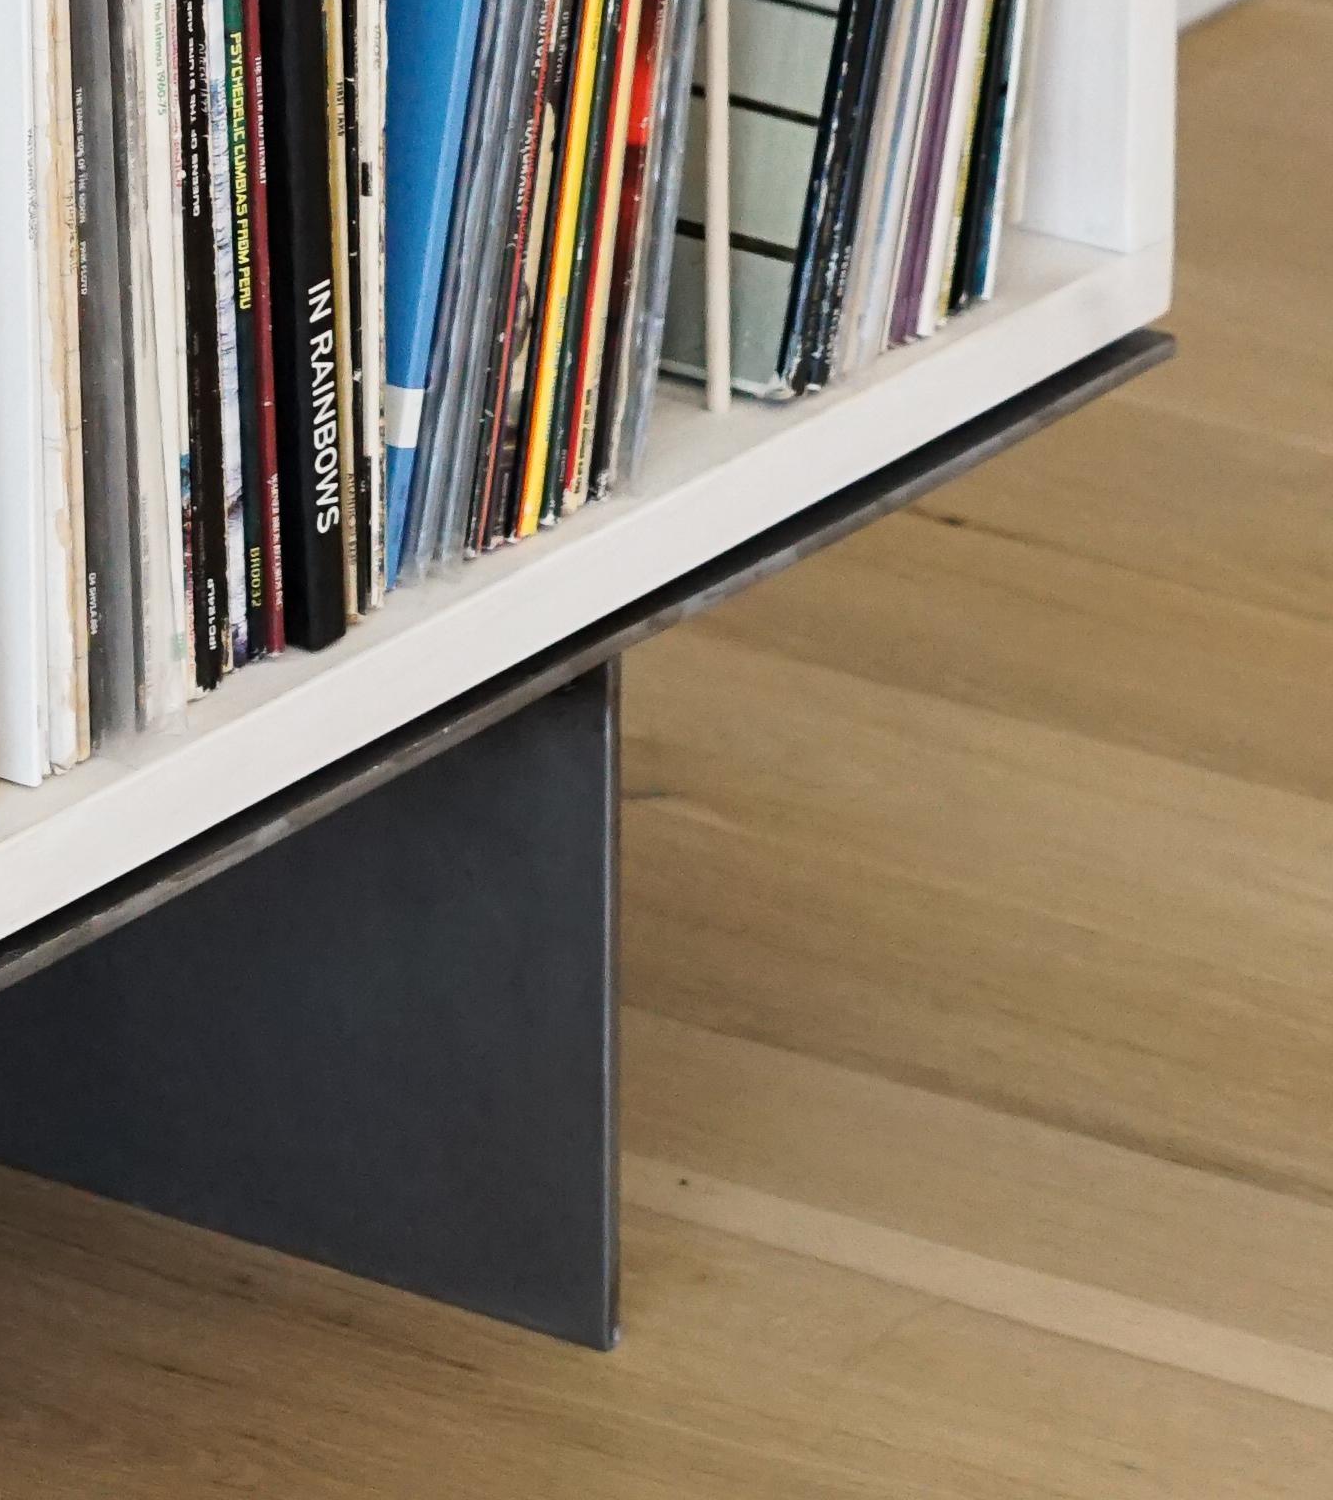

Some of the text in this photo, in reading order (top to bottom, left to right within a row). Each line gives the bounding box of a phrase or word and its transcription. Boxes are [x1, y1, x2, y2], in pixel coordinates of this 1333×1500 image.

[152, 2, 164, 21] the
[152, 22, 166, 68] Isthmus
[74, 87, 85, 107] THE
[155, 69, 168, 117] 1960-75
[185, 0, 201, 218] QUEENS OF THE STONE AGE
[229, 31, 246, 143] PSYCHEDELIC
[74, 107, 85, 134] DARK
[75, 158, 86, 173] OF
[232, 145, 248, 217] CUMBIAS
[256, 139, 267, 185] STEWART
[236, 218, 251, 264] FROM
[237, 266, 252, 311] PERU
[307, 278, 333, 324] IN
[309, 329, 340, 534] RAINBOWS
